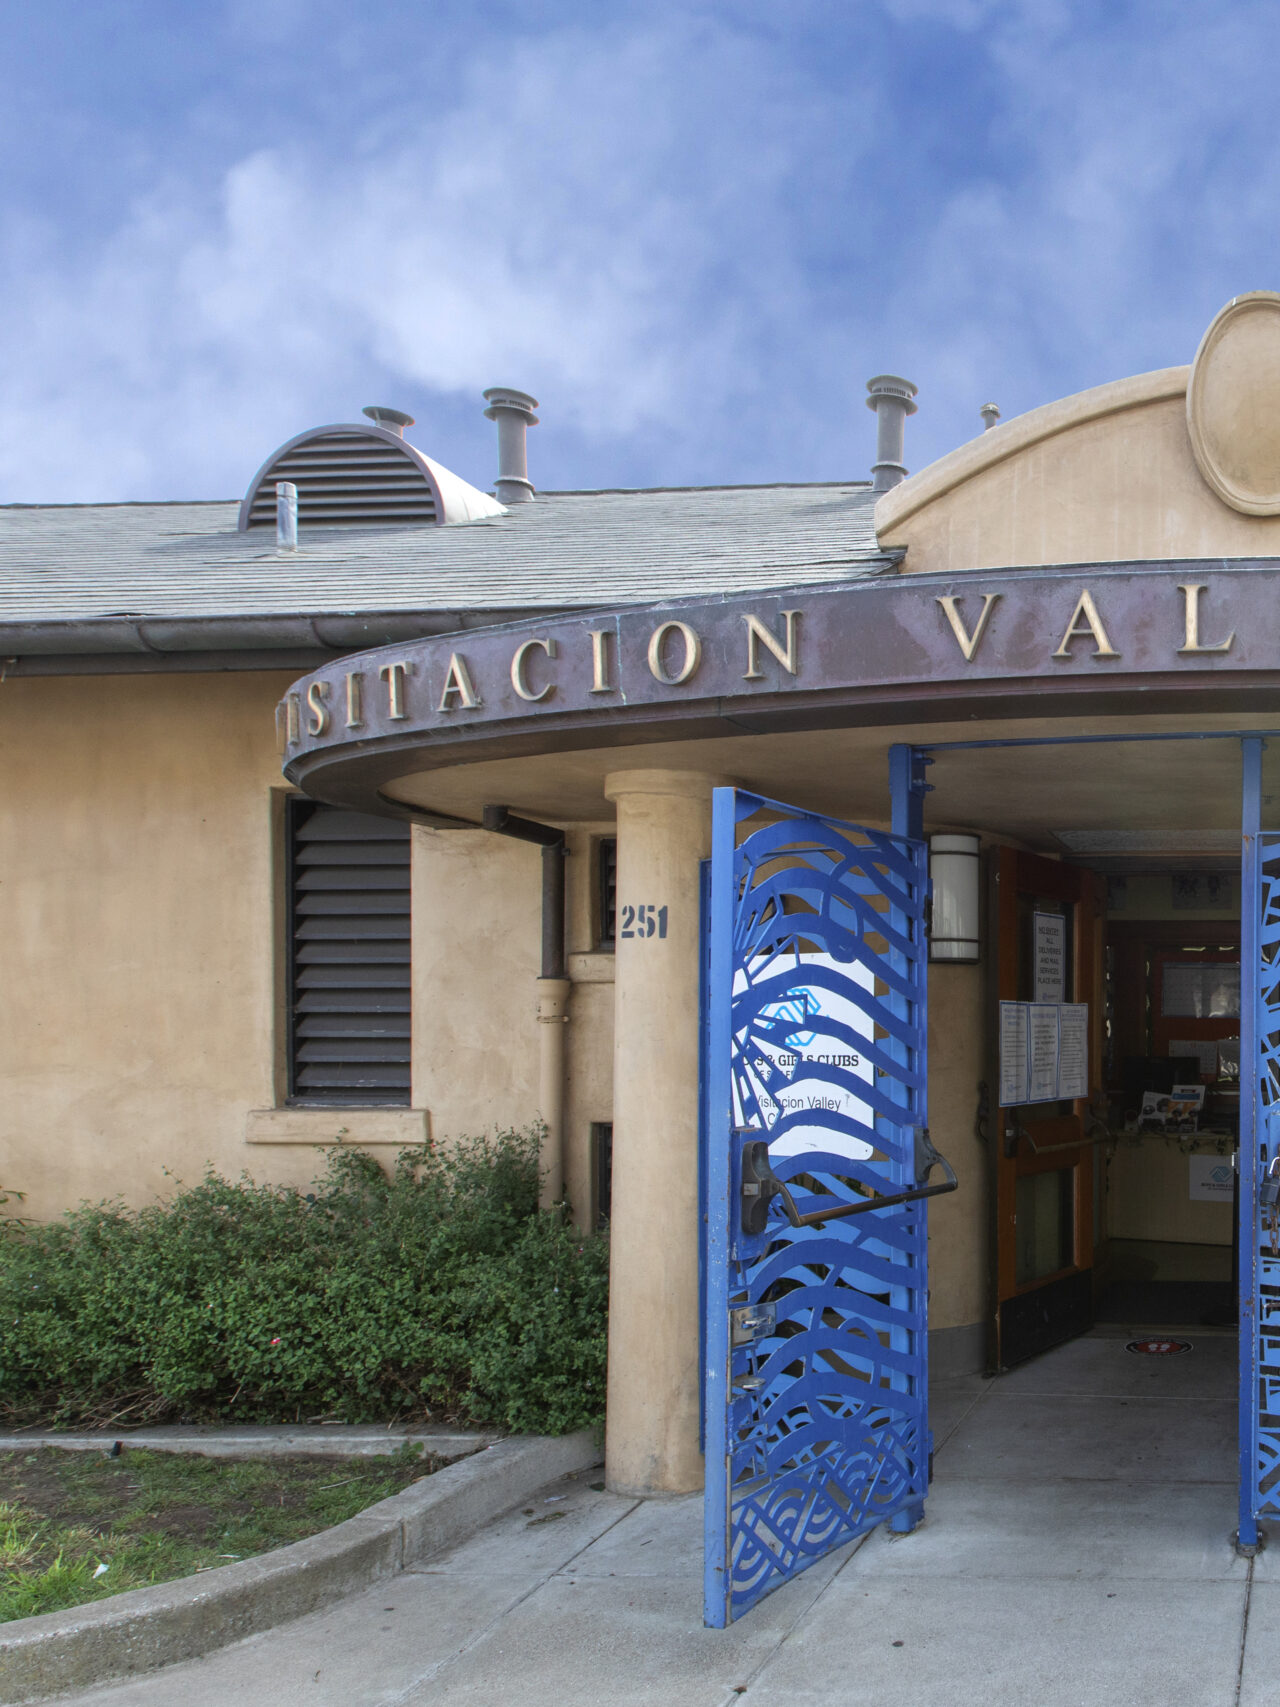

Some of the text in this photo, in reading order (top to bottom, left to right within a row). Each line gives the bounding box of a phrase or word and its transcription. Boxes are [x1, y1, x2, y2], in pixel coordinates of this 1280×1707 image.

[276, 609, 802, 745] ISITACION
[621, 905, 668, 938] 251
[778, 1055, 814, 1066] GIS
[817, 1055, 859, 1067] CLUBS
[758, 1095, 841, 1112] isicion Valley
